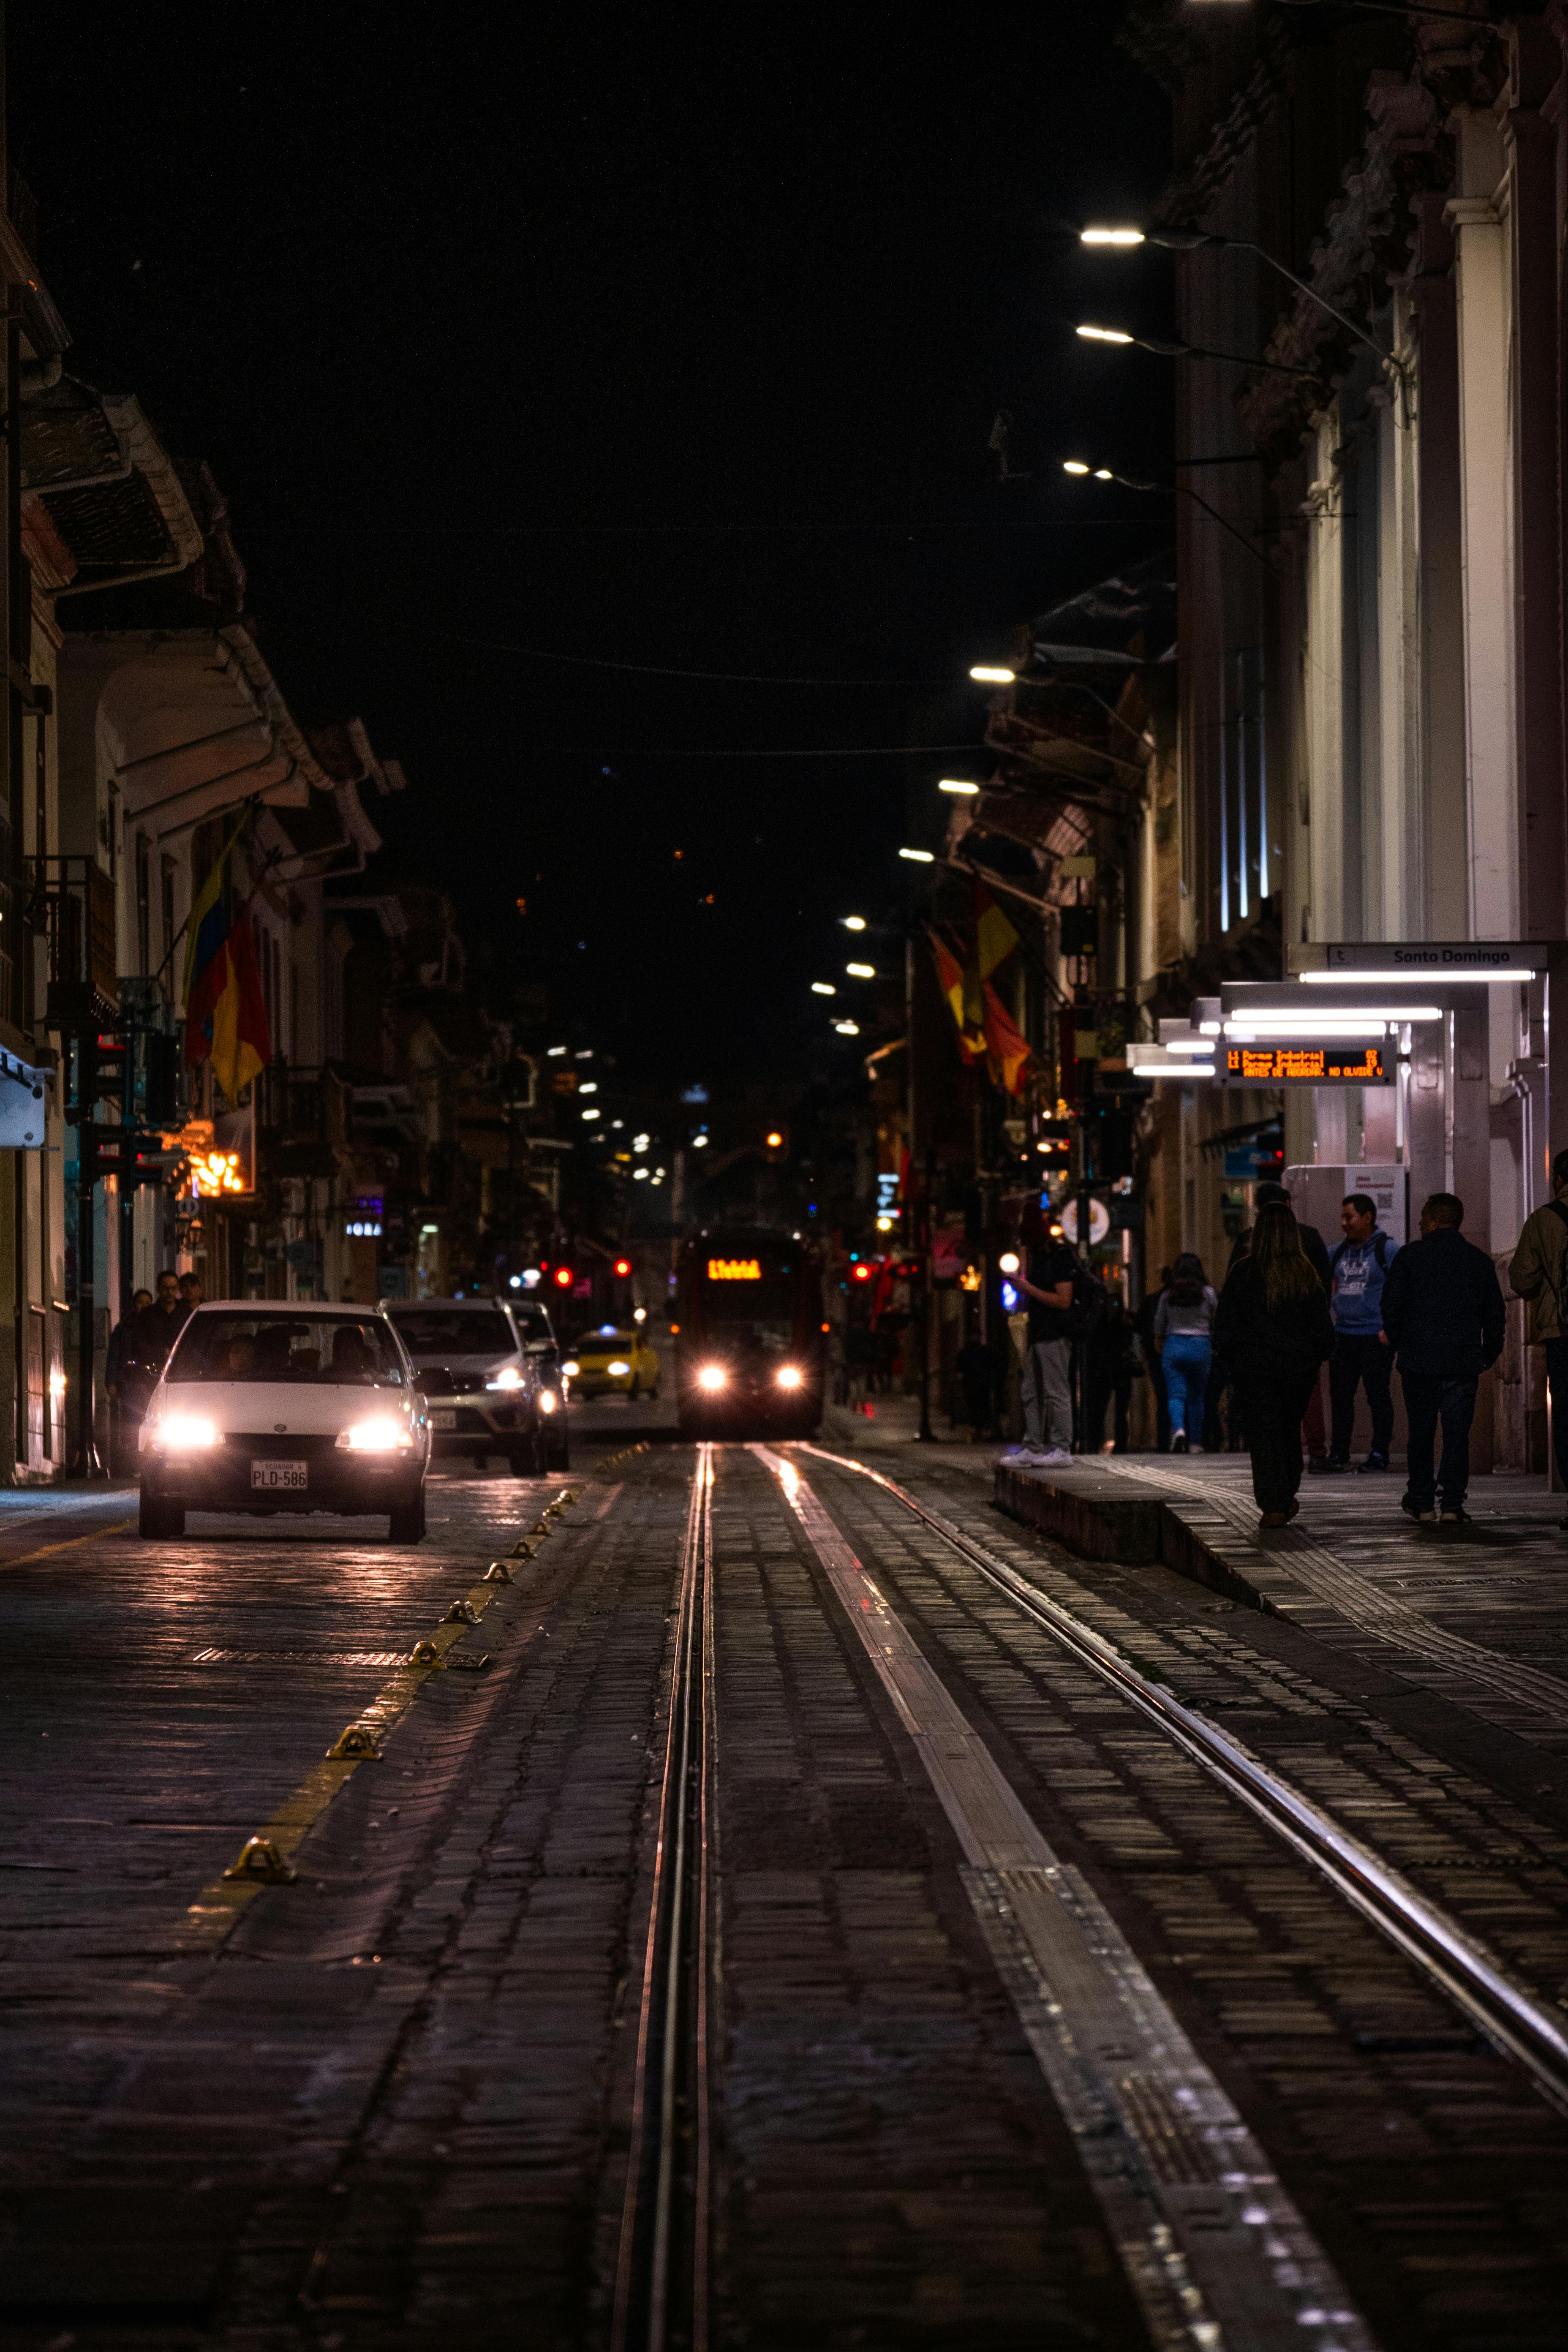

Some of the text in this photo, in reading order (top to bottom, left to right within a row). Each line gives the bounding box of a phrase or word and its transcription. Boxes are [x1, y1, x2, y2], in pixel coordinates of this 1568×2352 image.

[1394, 950, 1510, 965] Santo Domingo
[1276, 1050, 1324, 1060] Industrial
[1276, 1059, 1324, 1068] Industrial
[1244, 1067, 1269, 1077] ANTES
[1272, 1067, 1283, 1077] DE
[1328, 1067, 1341, 1077] NO
[1343, 1067, 1373, 1077] OLVIDE
[253, 1471, 305, 1486] PLD-586
